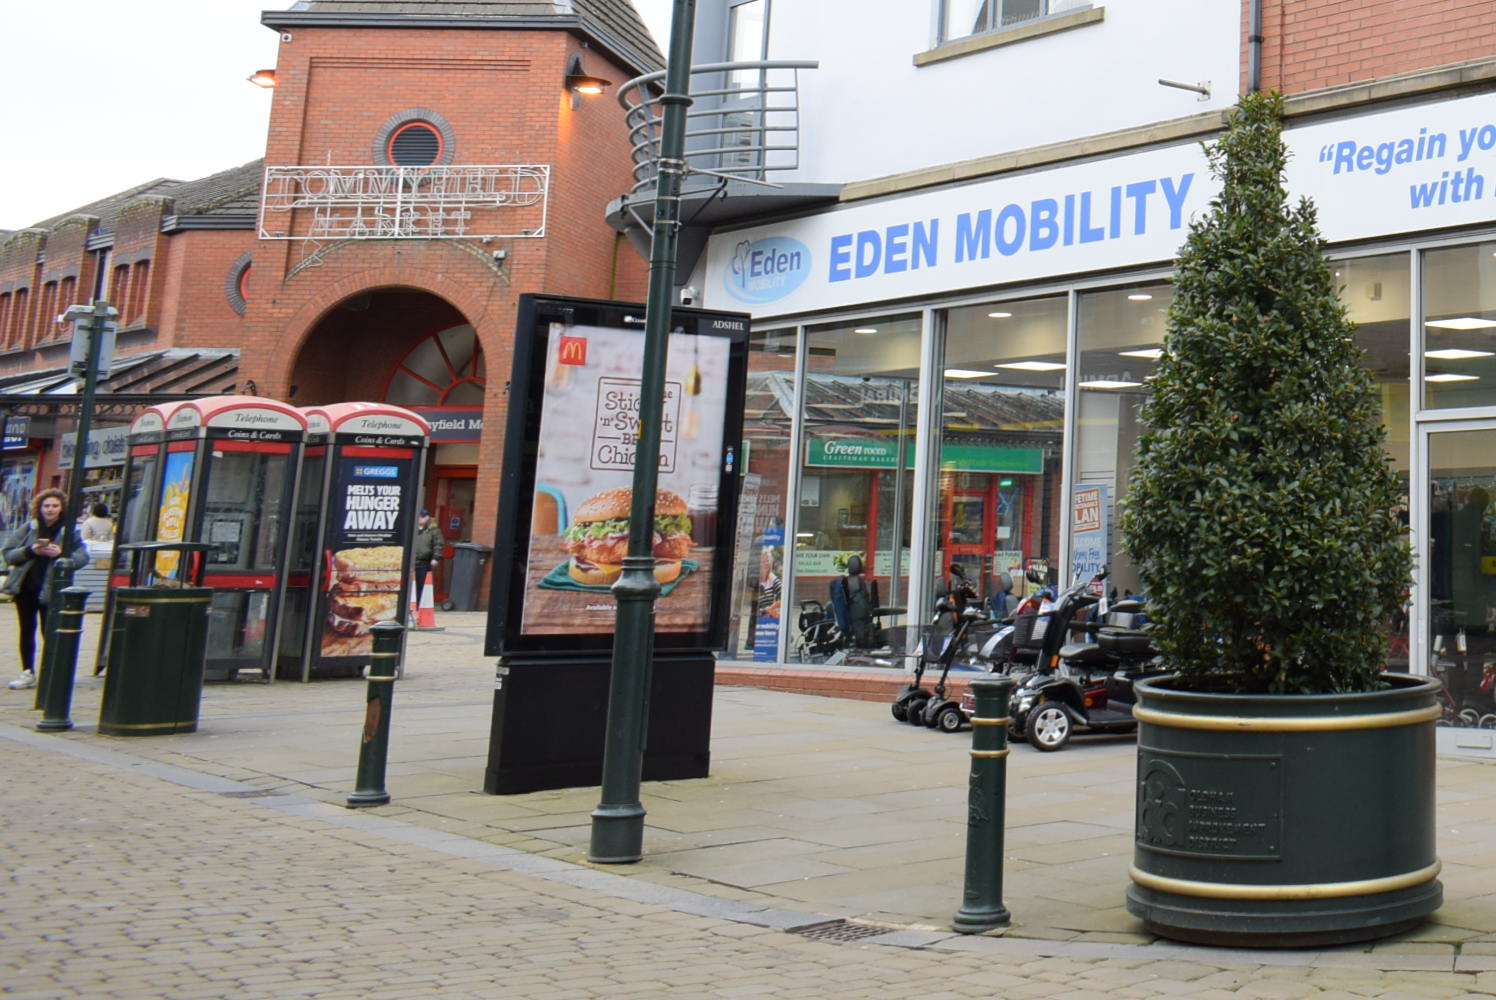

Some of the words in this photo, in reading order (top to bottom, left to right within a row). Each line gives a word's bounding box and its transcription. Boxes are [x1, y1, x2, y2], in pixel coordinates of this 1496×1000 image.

[268, 168, 545, 212] TOMMYFIELD
[1409, 163, 1484, 209] with
[828, 218, 939, 283] EDEN
[954, 173, 1196, 264] MOBILITY
[751, 248, 801, 278] Eden
[712, 320, 745, 331] ADSHEL
[235, 412, 280, 424] Telephone
[361, 419, 403, 430] Telephone
[427, 419, 466, 432] yfield
[615, 411, 673, 433] Swt
[227, 430, 250, 439] Coins
[260, 431, 282, 440] Cards
[598, 445, 669, 467] Chicn
[824, 440, 862, 455] Green
[863, 447, 887, 456] room
[347, 485, 375, 496] MELTS
[376, 485, 401, 496] YOUR
[346, 496, 400, 511] HUNGER
[344, 511, 399, 530] AWAY
[1074, 507, 1099, 523] LAN
